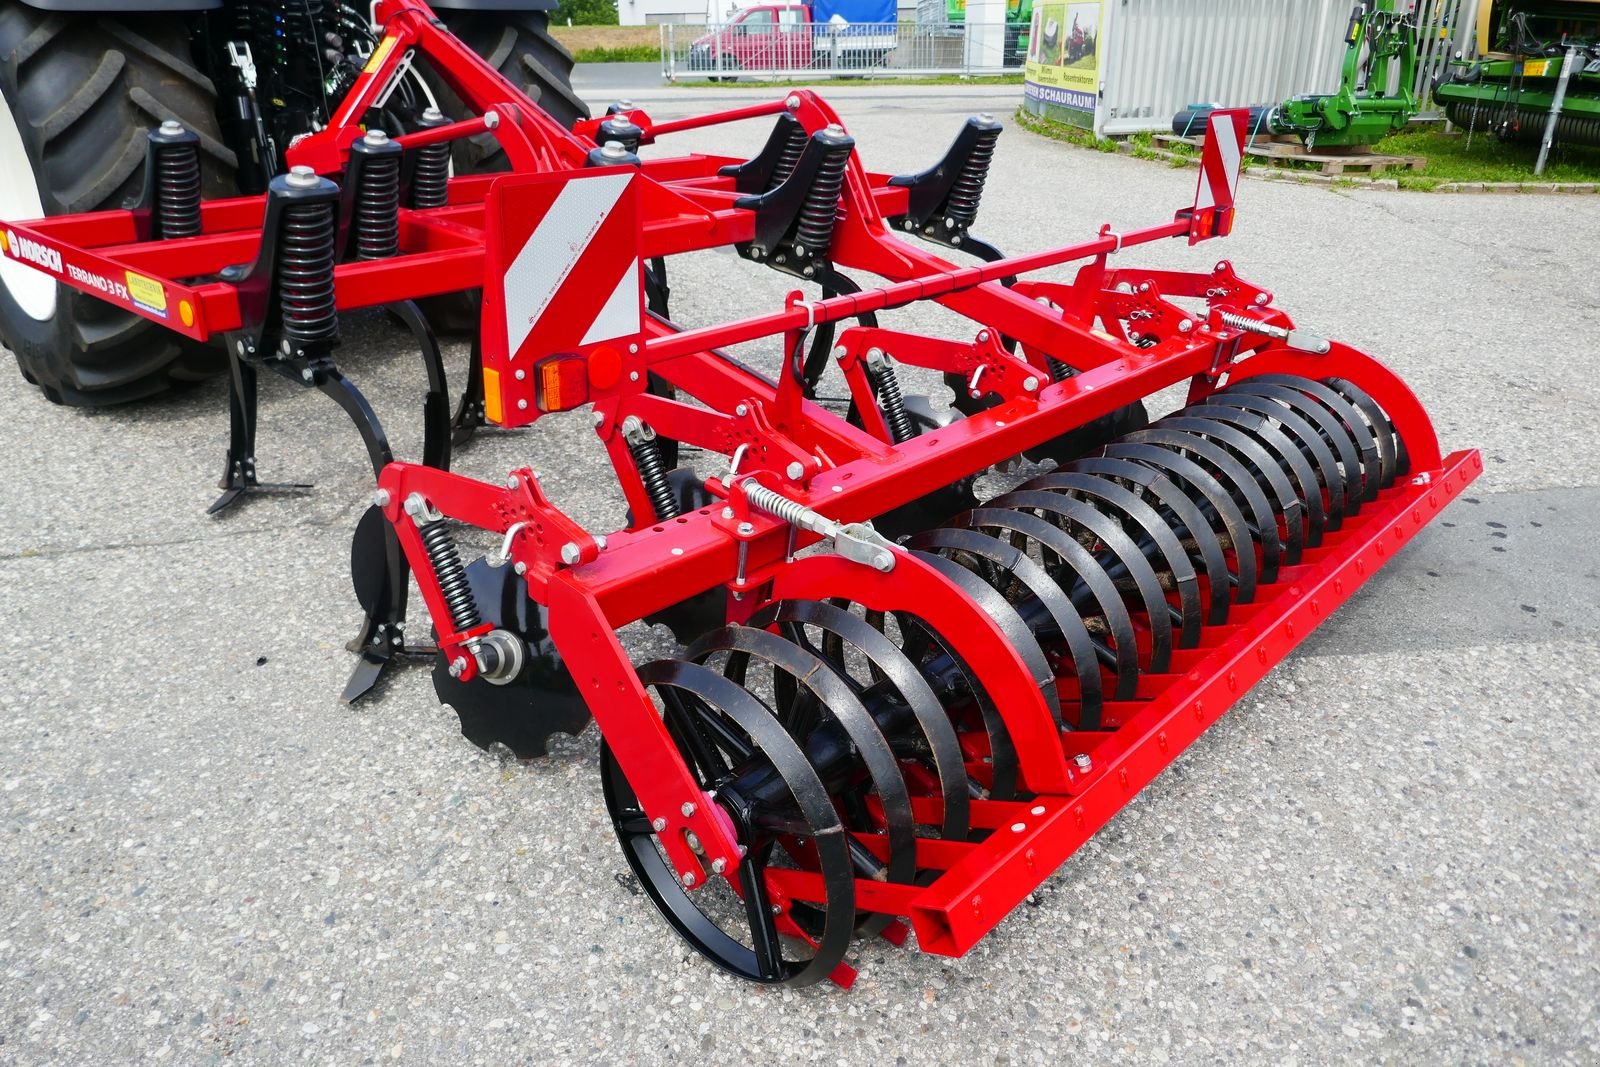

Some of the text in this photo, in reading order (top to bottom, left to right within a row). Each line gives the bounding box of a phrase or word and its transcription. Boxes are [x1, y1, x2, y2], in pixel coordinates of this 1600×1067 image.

[1039, 88, 1095, 109] SCHAURAUM!
[19, 236, 63, 274] HORSCH
[66, 263, 107, 291] TERRANO
[106, 279, 116, 295] 3
[114, 282, 130, 301] FX
